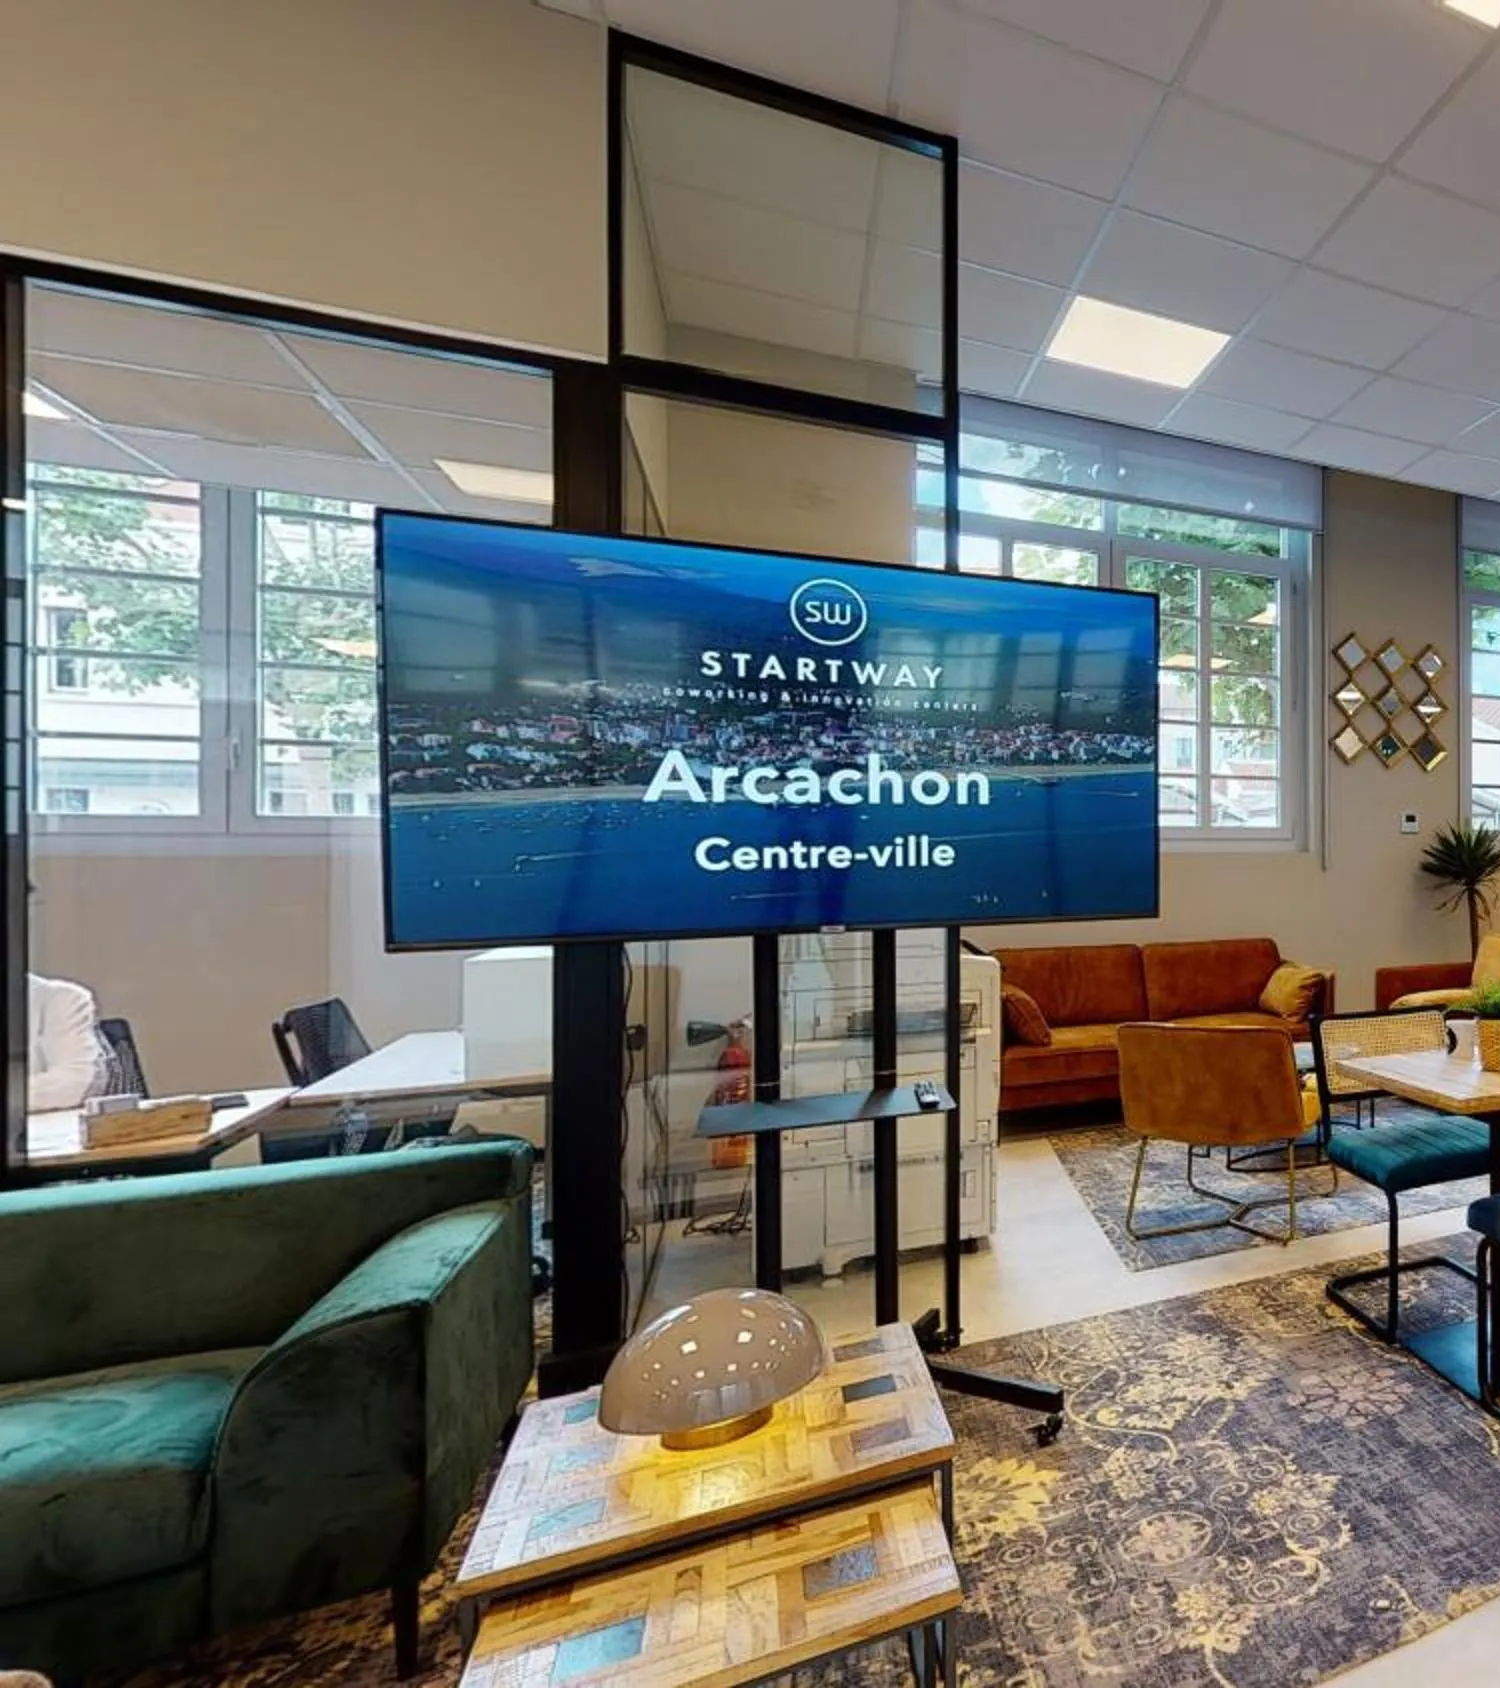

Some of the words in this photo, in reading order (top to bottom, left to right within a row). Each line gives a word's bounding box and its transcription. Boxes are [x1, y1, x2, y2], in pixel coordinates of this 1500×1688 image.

[700, 650, 944, 690] STARTWAY
[643, 749, 992, 807] Arcachon
[694, 834, 957, 873] Centre-ville
